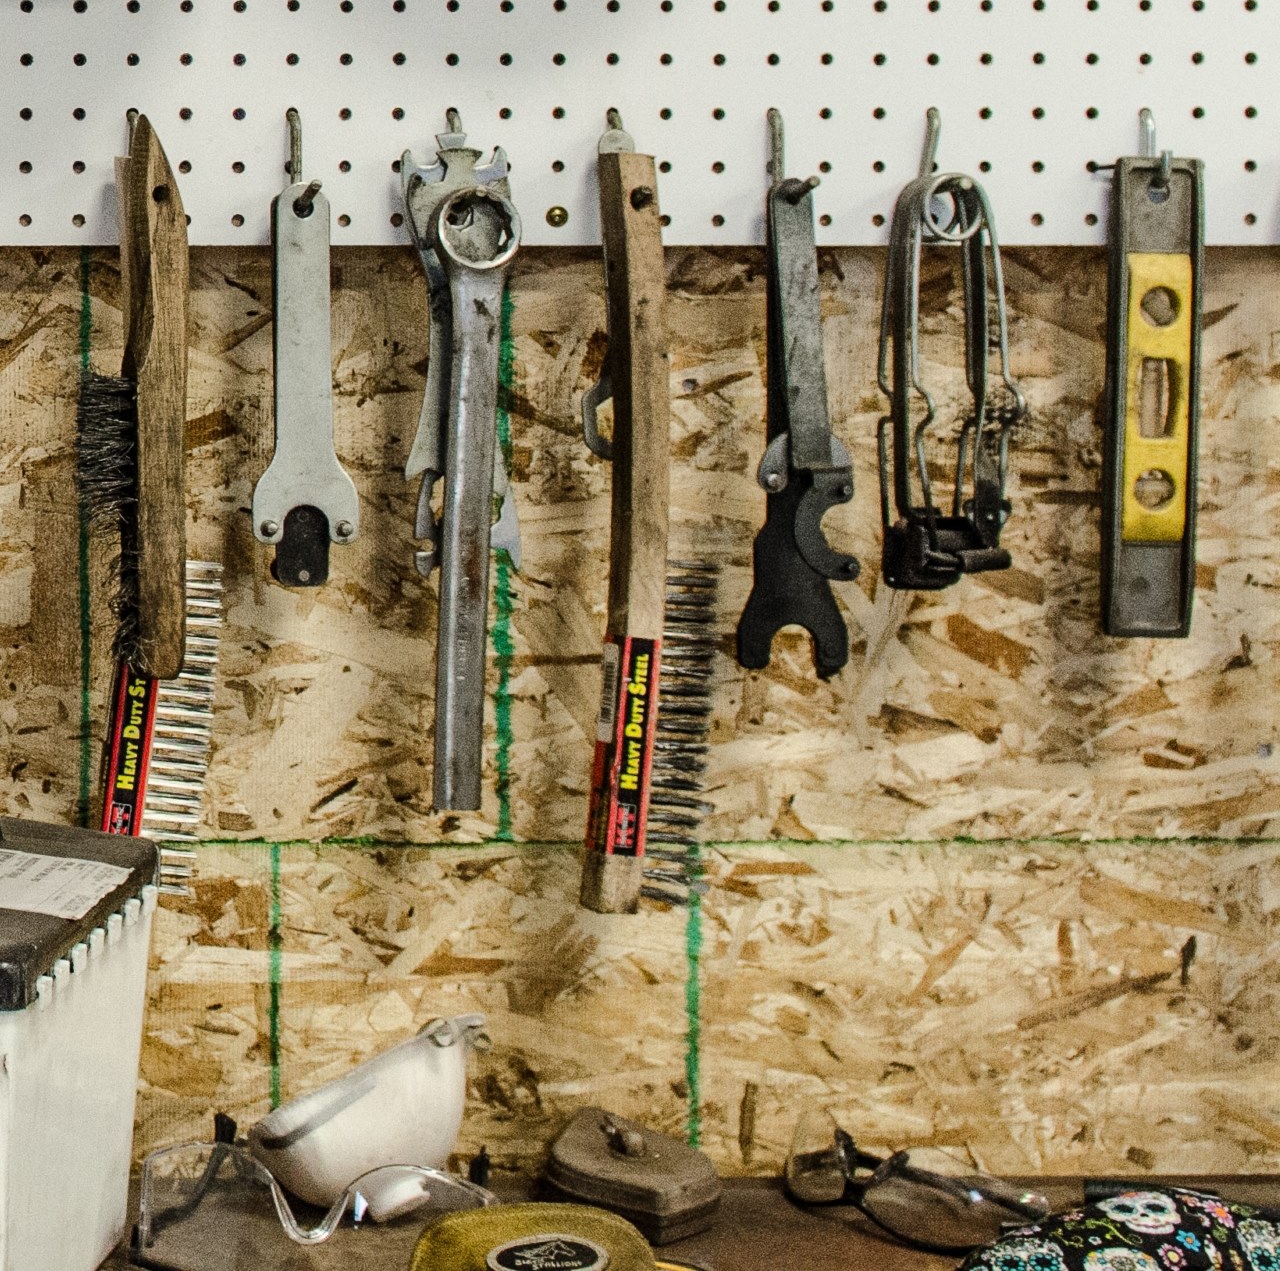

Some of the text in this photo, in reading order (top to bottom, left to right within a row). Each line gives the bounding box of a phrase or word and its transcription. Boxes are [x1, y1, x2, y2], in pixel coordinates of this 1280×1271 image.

[123, 700, 145, 740] DUTY
[620, 654, 650, 790] HEAVY DUTY STEEL
[116, 741, 140, 791] HEAVY
